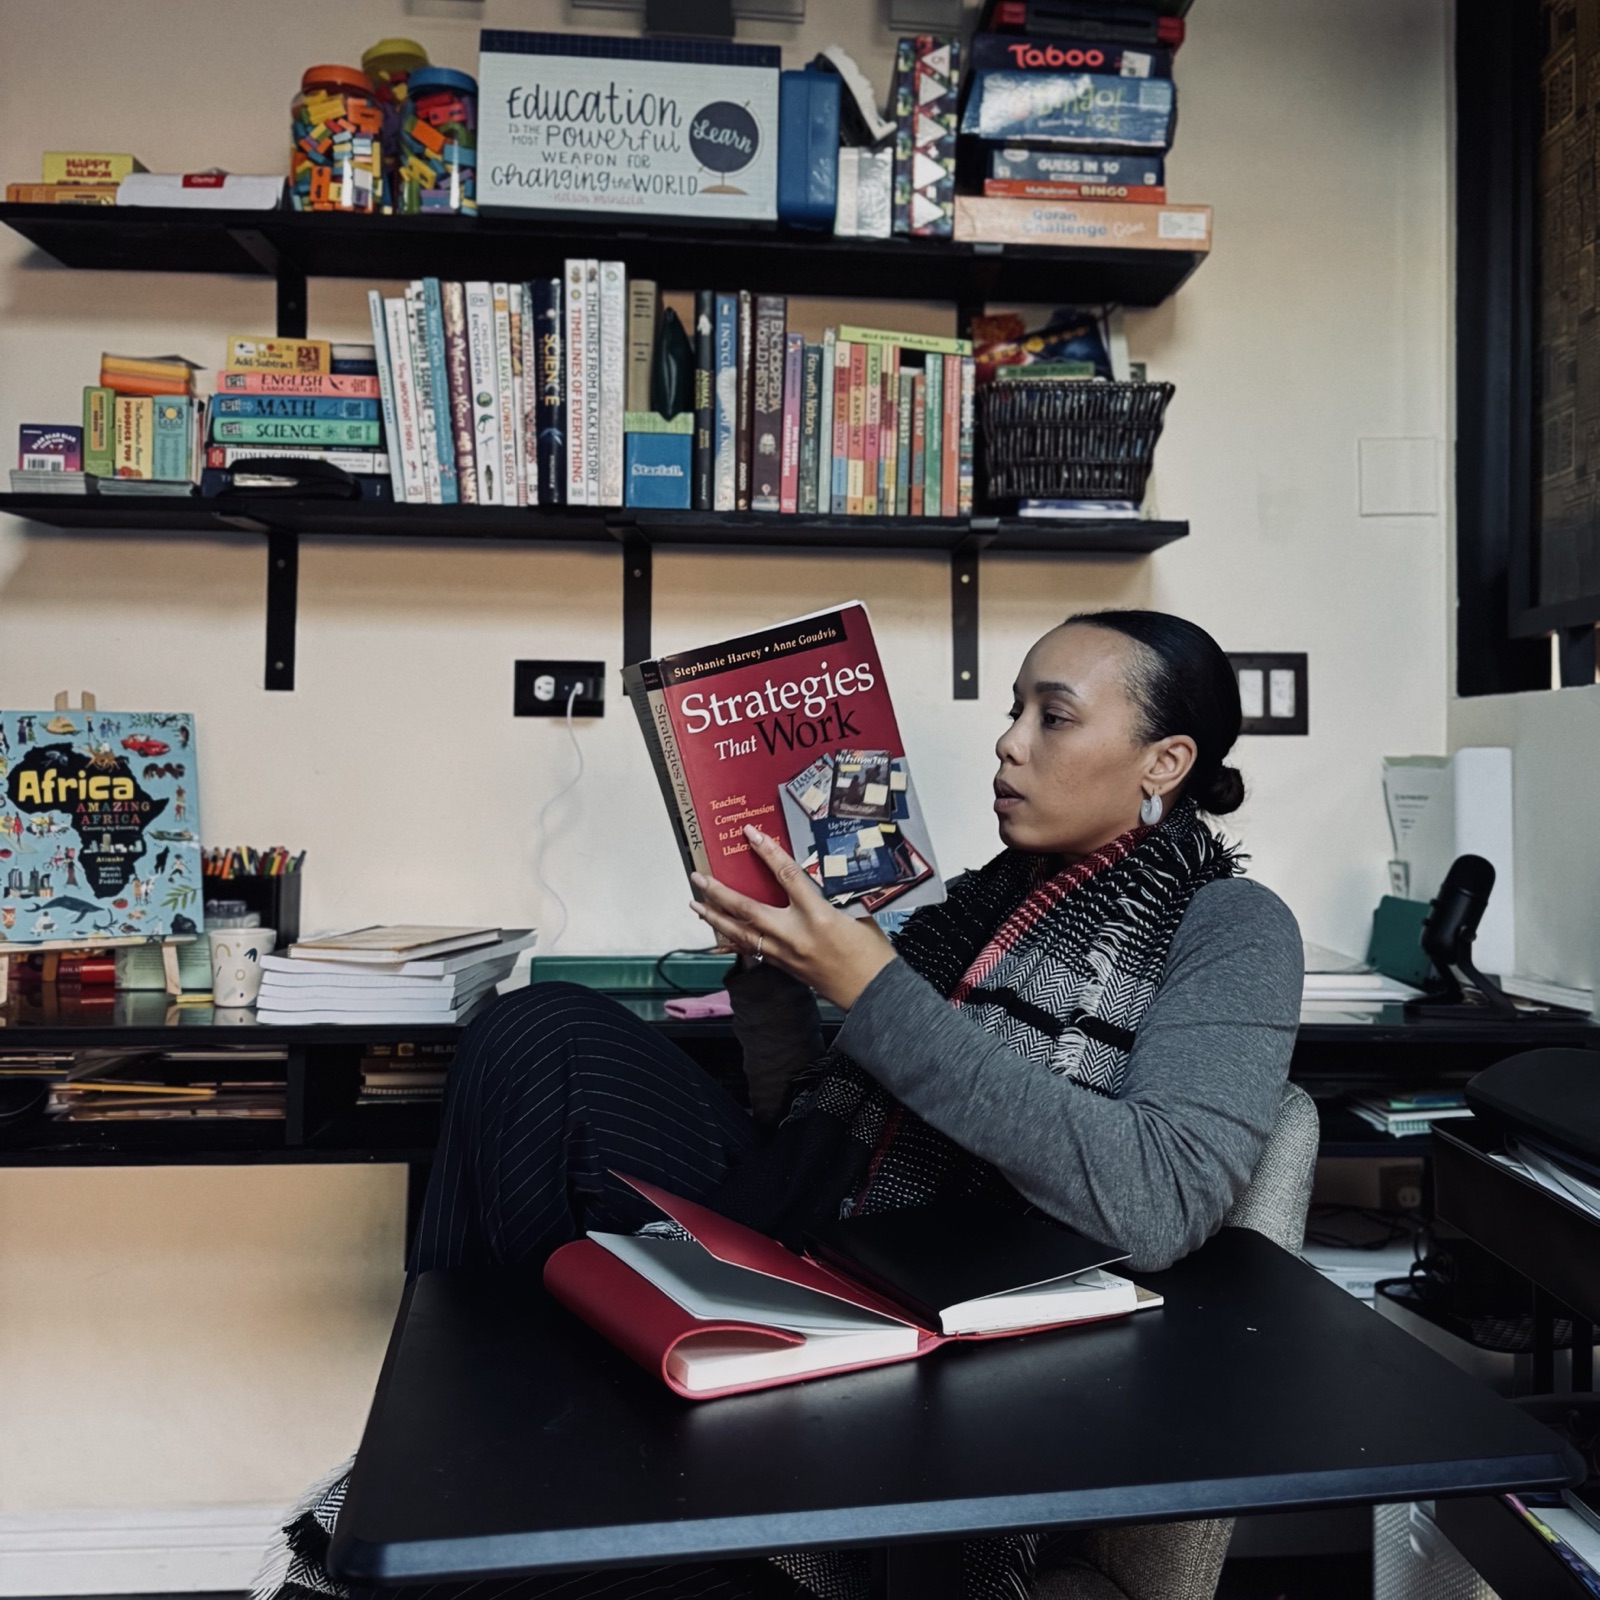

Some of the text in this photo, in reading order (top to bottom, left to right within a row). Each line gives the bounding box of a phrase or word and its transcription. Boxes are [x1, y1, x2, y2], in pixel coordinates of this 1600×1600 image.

[1008, 44, 1104, 69] Taboo
[506, 81, 682, 128] Education
[508, 124, 541, 135] IS THE
[511, 135, 540, 146] MOST
[546, 124, 681, 153] Powerful
[693, 119, 752, 153] Learn
[66, 159, 111, 169] HAPPY
[541, 151, 651, 168] WEAPON FOR
[1037, 159, 1119, 174] GUESS IN 10
[611, 177, 633, 190] the
[632, 174, 698, 196] WORLD
[1080, 185, 1128, 197] BINGO
[1022, 220, 1108, 236] Challenge
[429, 309, 442, 366] Water Cycles
[471, 314, 483, 384] ENCYCLOPEDIA
[415, 308, 434, 411] MAMMOTH SCIENCE
[523, 332, 536, 406] PHILOSOPHY
[544, 333, 559, 406] SCIENCE
[755, 318, 769, 414] WORLD HISTORY
[768, 320, 783, 412] ENCYCLOPEDIA
[808, 353, 819, 372] Fun
[261, 374, 322, 386] ENGLISH
[587, 292, 598, 482] TIMELINES FROM BLACK HISTORY
[700, 369, 709, 408] ANIMAL
[806, 373, 818, 397] with
[255, 399, 315, 416] MATH
[400, 381, 411, 422] IMPORTANT
[570, 308, 583, 484] TIMELINES OF EVERYTHING
[256, 423, 320, 439] SCIENCE
[501, 395, 511, 442] FLOWERS
[721, 412, 731, 427] OF
[804, 399, 817, 434] Nature
[852, 396, 862, 447] ANATOMY
[869, 393, 880, 447] ANATOMY
[899, 397, 909, 445] COMPOST
[915, 407, 924, 436] GROW
[404, 424, 414, 450] THINGS
[504, 453, 514, 485] SEEDS
[739, 462, 747, 491] JOHNSON
[674, 627, 837, 678] Stephanie Harvey Anne Goudvis
[681, 661, 875, 734] Strategies
[714, 700, 861, 761] That Work
[18, 769, 134, 804] Africa
[655, 703, 702, 850] Strategies That Work
[790, 769, 817, 792] TIME
[76, 802, 150, 813] AMAZING
[710, 795, 747, 811] Teaching
[714, 804, 775, 826] Comprehension
[81, 814, 141, 825] AFRICA
[719, 832, 729, 841] to
